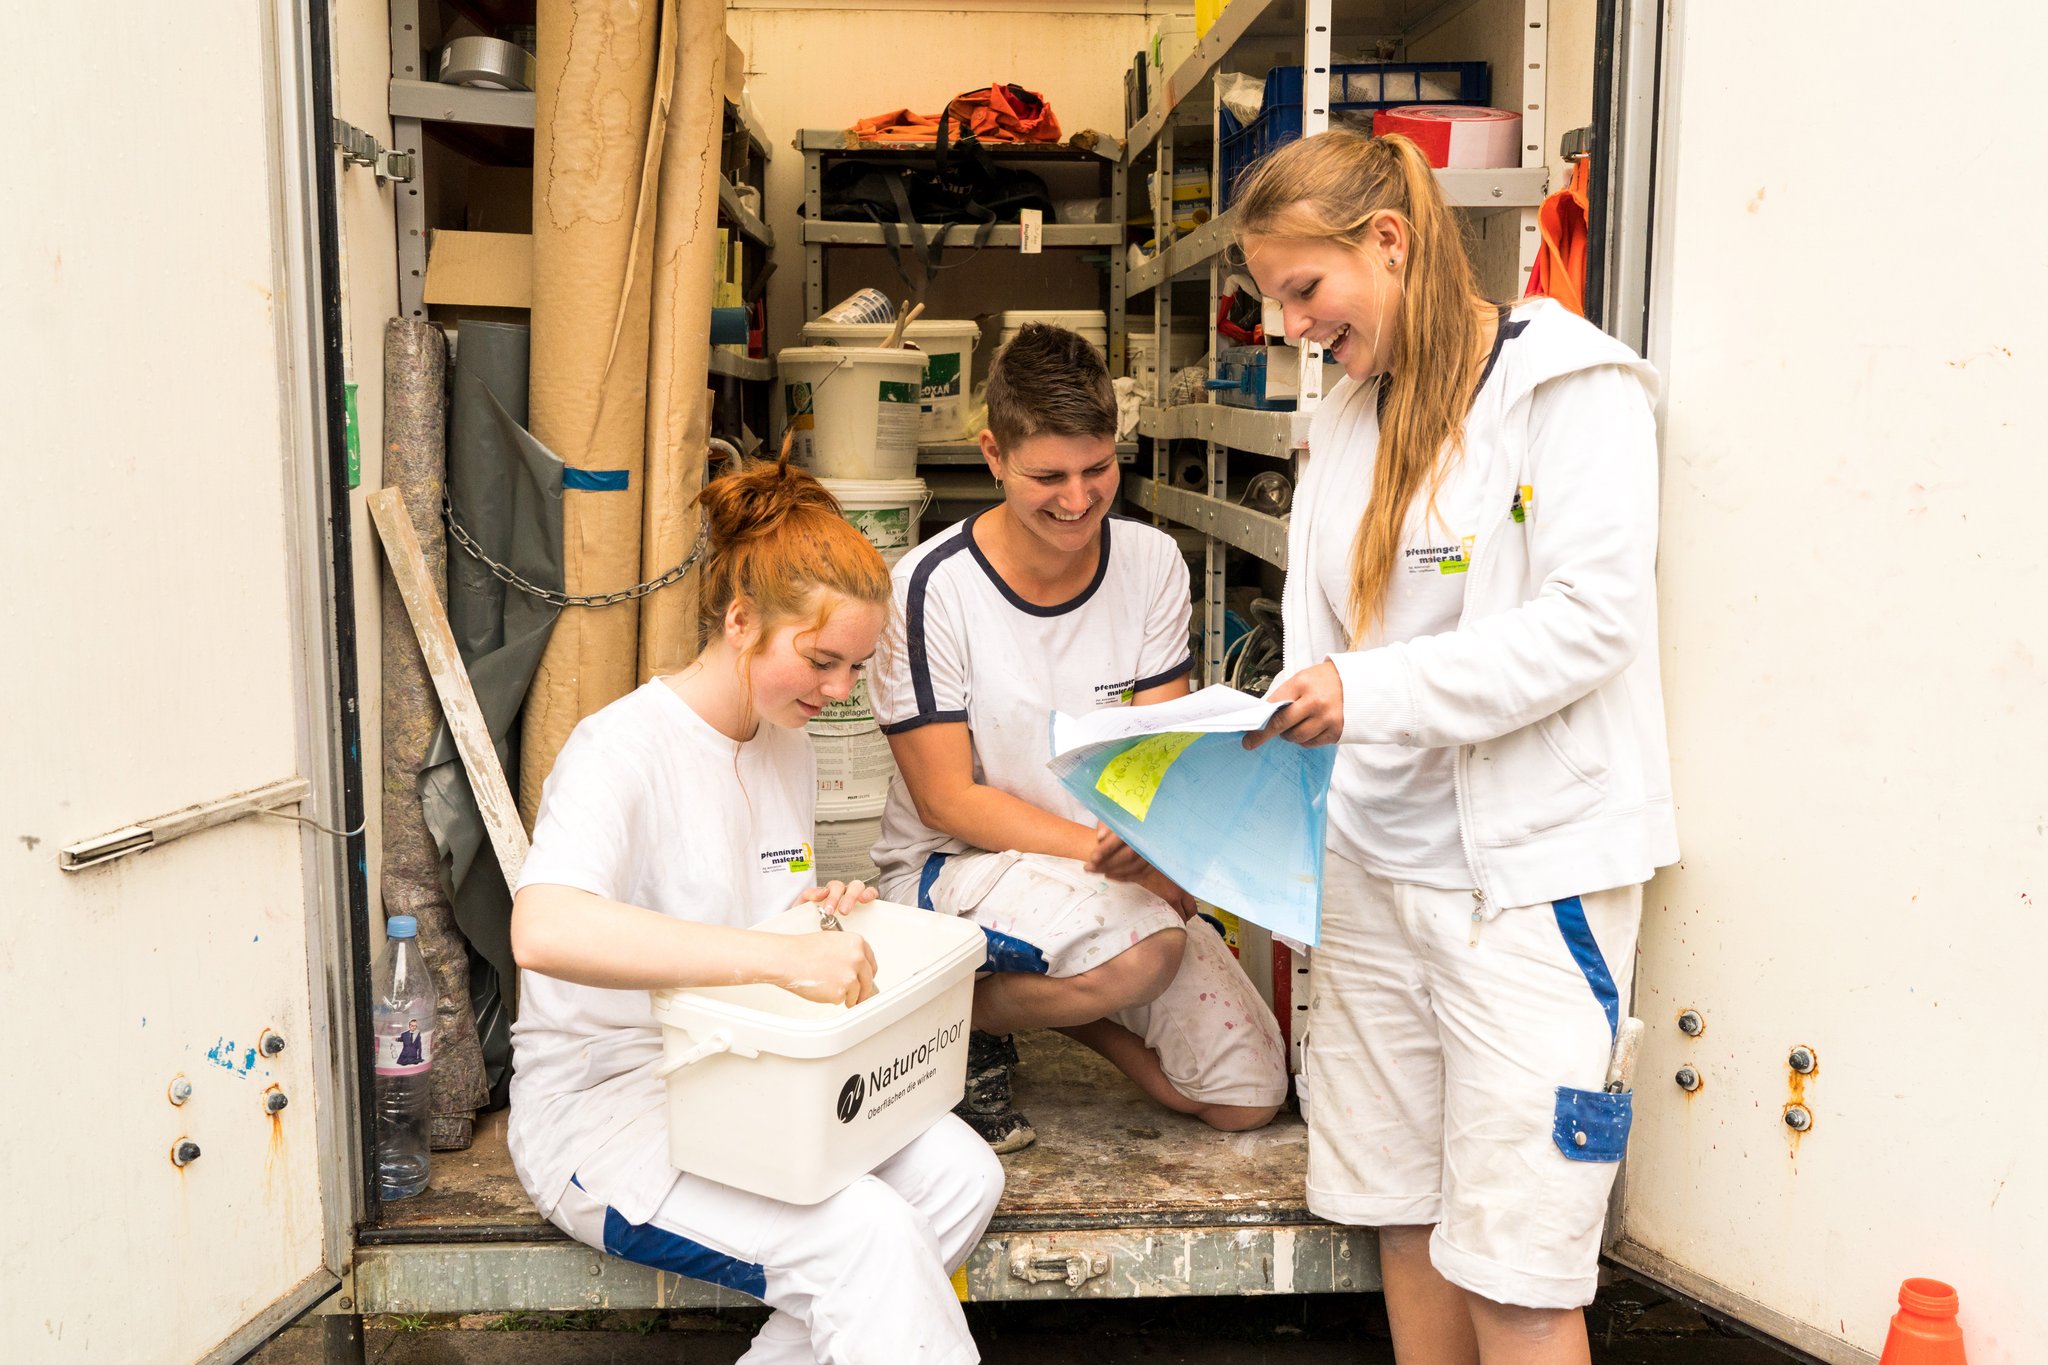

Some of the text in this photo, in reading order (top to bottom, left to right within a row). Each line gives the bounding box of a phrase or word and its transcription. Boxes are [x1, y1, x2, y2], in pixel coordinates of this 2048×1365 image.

[1406, 545, 1461, 557] pfenninger
[1419, 554, 1462, 564] maler ag
[1094, 679, 1135, 692] pfenninger
[1107, 688, 1127, 697] maler
[839, 708, 871, 718] gelagert
[761, 848, 803, 860] pfenninger
[772, 856, 795, 865] maler
[868, 1019, 964, 1097] NaturoFloor
[867, 1067, 937, 1120] Oberflächen die wirken
